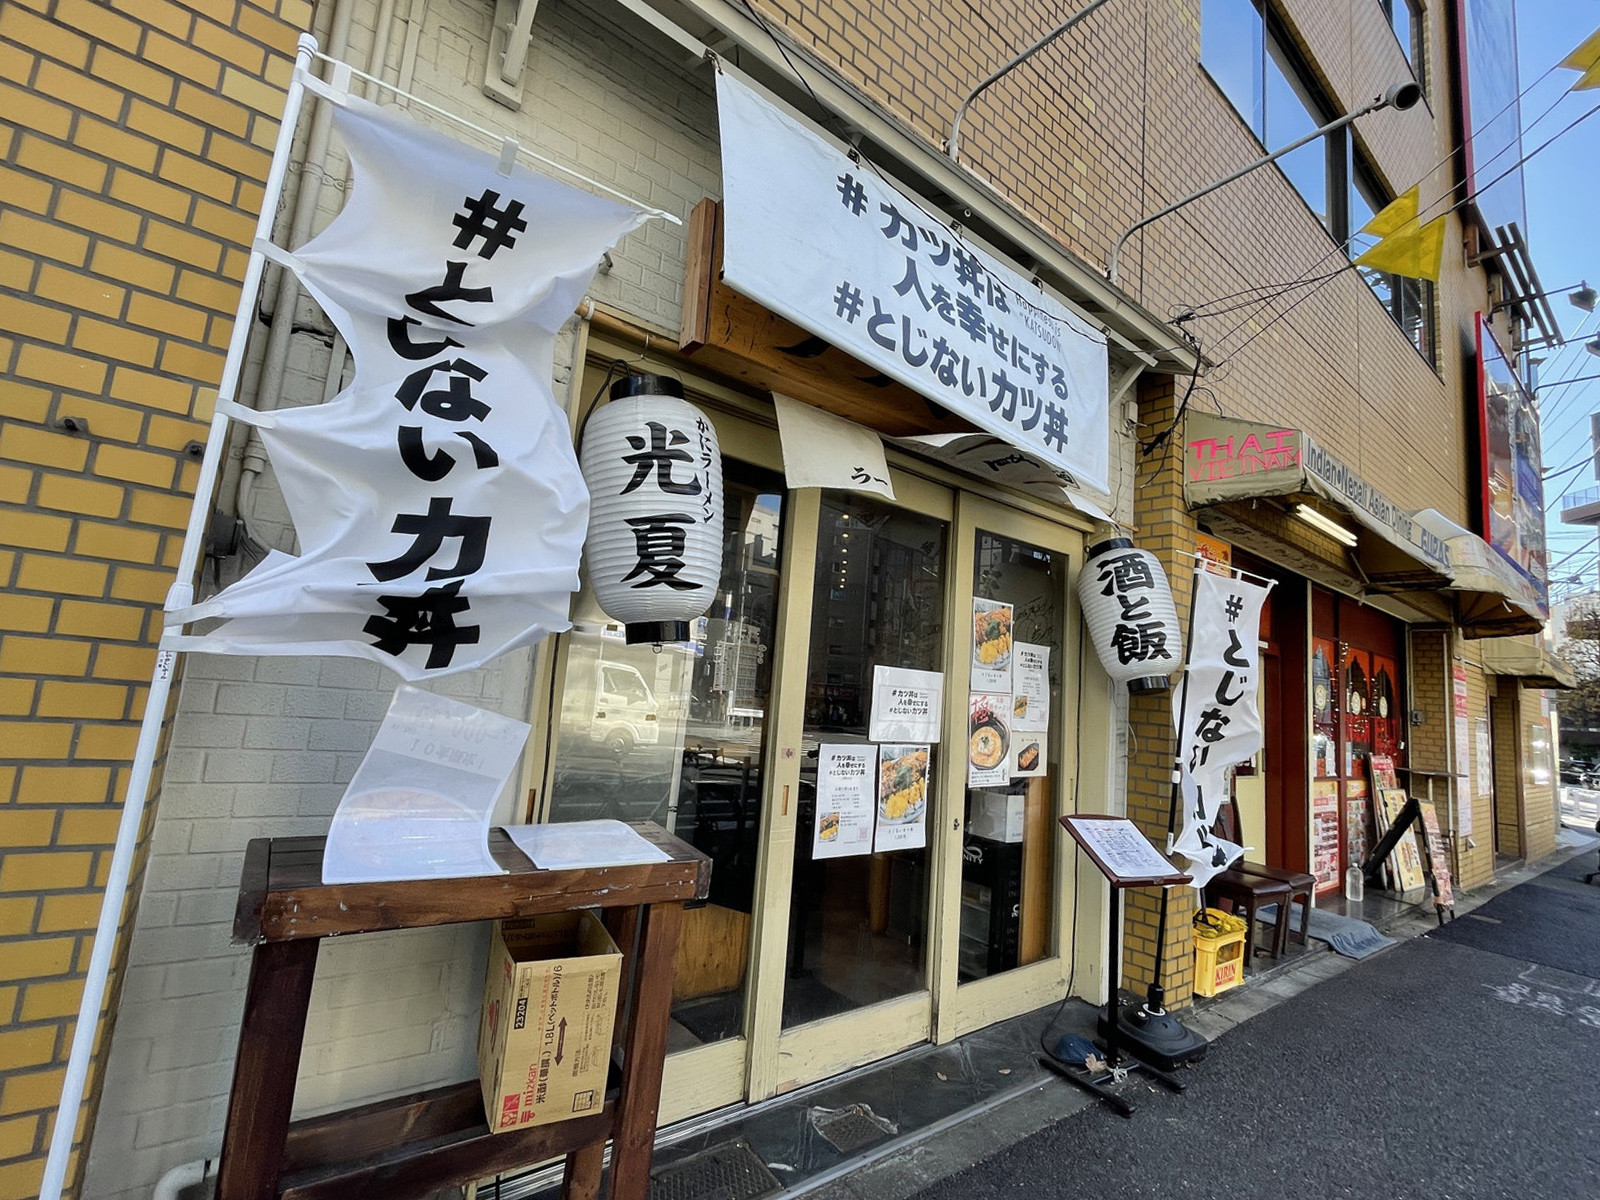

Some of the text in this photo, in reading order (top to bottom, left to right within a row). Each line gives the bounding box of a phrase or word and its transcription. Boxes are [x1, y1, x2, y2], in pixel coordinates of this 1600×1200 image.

[893, 256, 1069, 400] 人を幸せにする
[832, 280, 1069, 453] #とじないカツ丼
[1188, 429, 1294, 460] THAI
[1188, 449, 1302, 482] VIETNAM
[696, 416, 715, 524] かにラーメン
[619, 420, 704, 592] 光夏
[1369, 488, 1391, 524] Asian
[1096, 552, 1172, 666] 酒と飯
[1215, 964, 1236, 982] KIRIN
[515, 999, 527, 1028] 23204
[523, 1063, 538, 1106] mizkan
